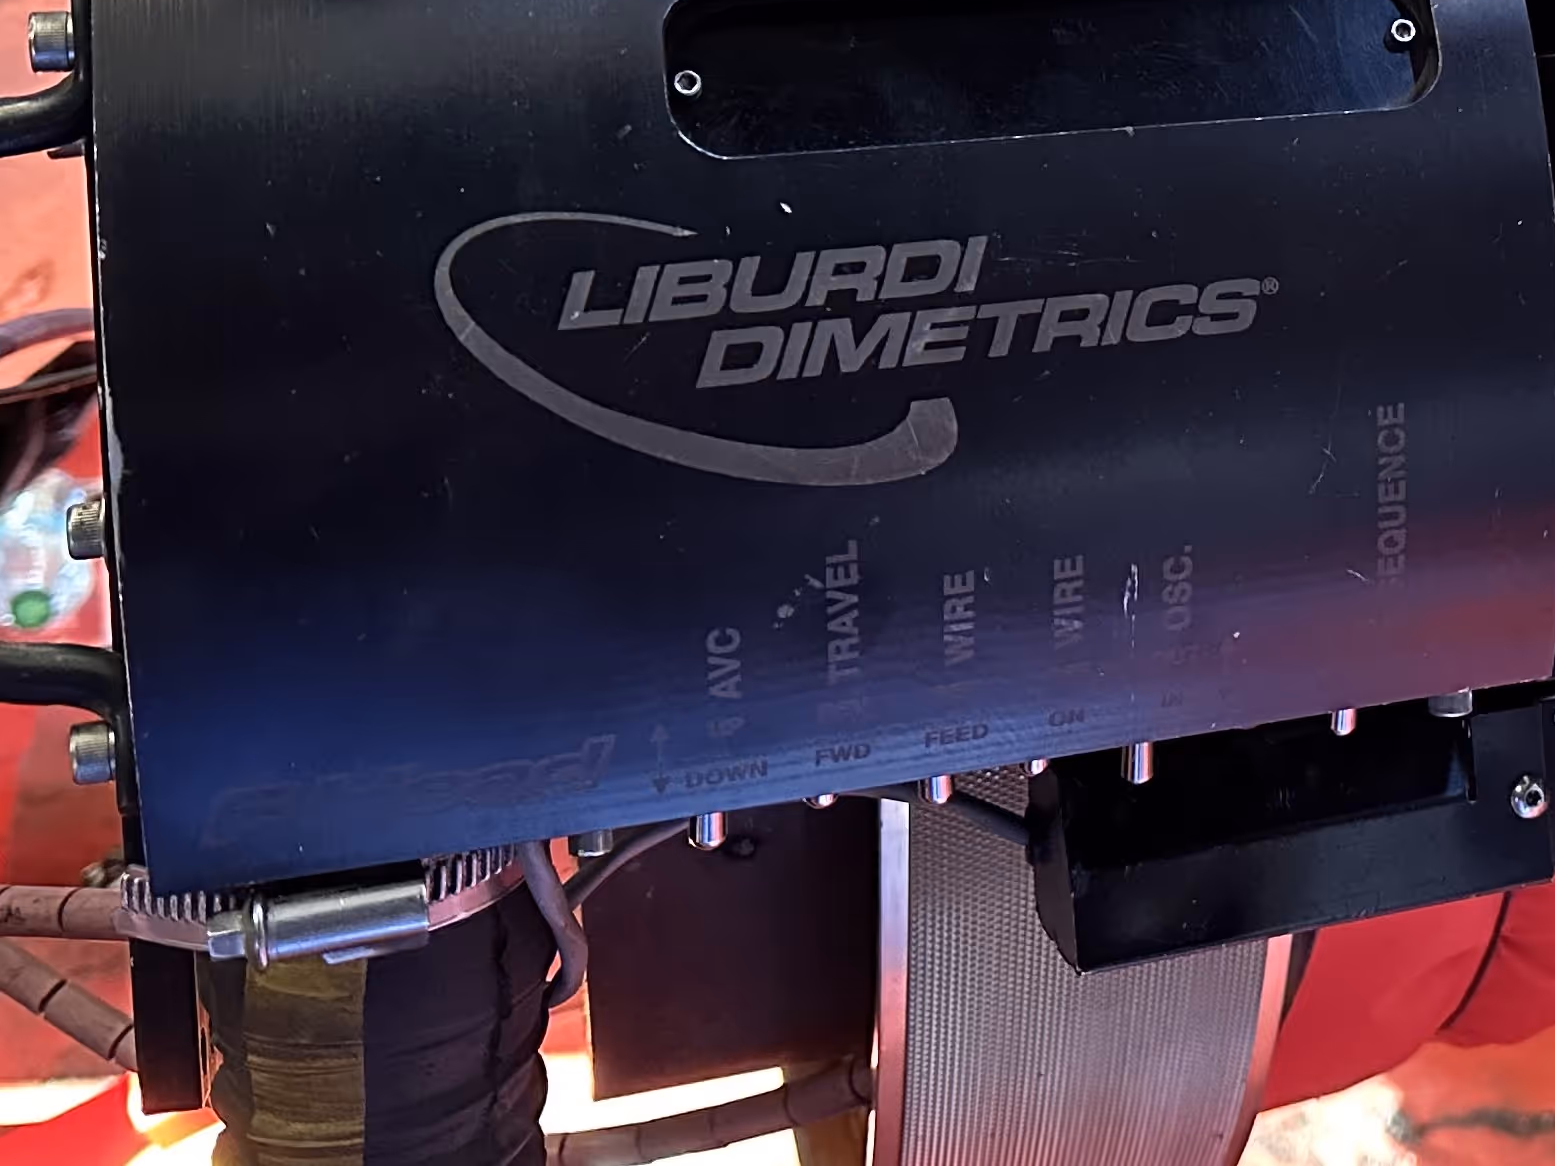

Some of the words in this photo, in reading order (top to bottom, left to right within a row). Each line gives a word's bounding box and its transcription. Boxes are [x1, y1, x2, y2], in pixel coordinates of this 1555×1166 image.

[556, 234, 989, 331] LIBURDI
[824, 539, 861, 685] TRAVEL
[941, 569, 976, 668] WIRE
[1052, 553, 1085, 651] WIRE
[1161, 543, 1194, 631] OSC.
[706, 625, 744, 700] AVC
[814, 742, 872, 767] FWD
[923, 722, 990, 749] FEED
[1047, 707, 1086, 727] ON
[684, 758, 769, 790] DOWN
